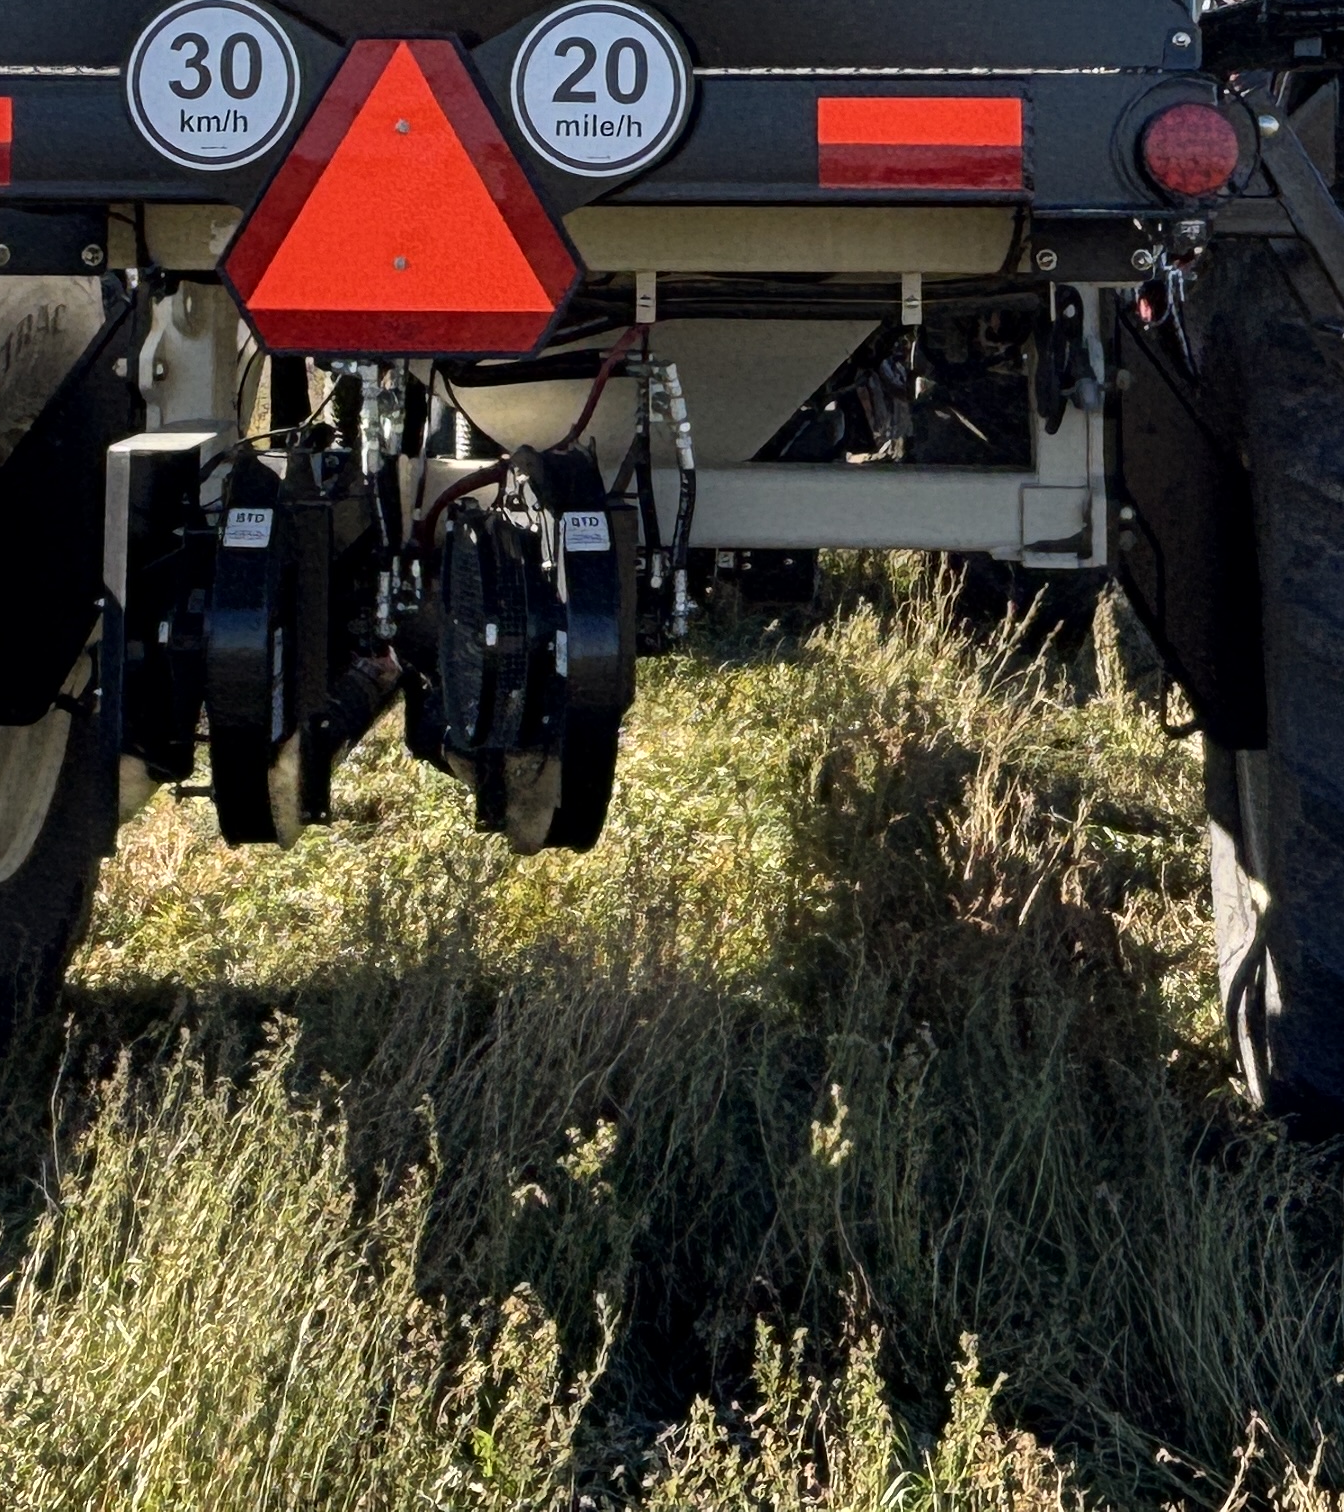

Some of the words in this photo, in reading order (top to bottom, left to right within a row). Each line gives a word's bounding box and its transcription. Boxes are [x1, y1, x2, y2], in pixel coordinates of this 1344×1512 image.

[168, 31, 263, 101] 30
[551, 36, 649, 105] 20
[179, 108, 248, 134] km/h
[555, 113, 643, 139] mile/h
